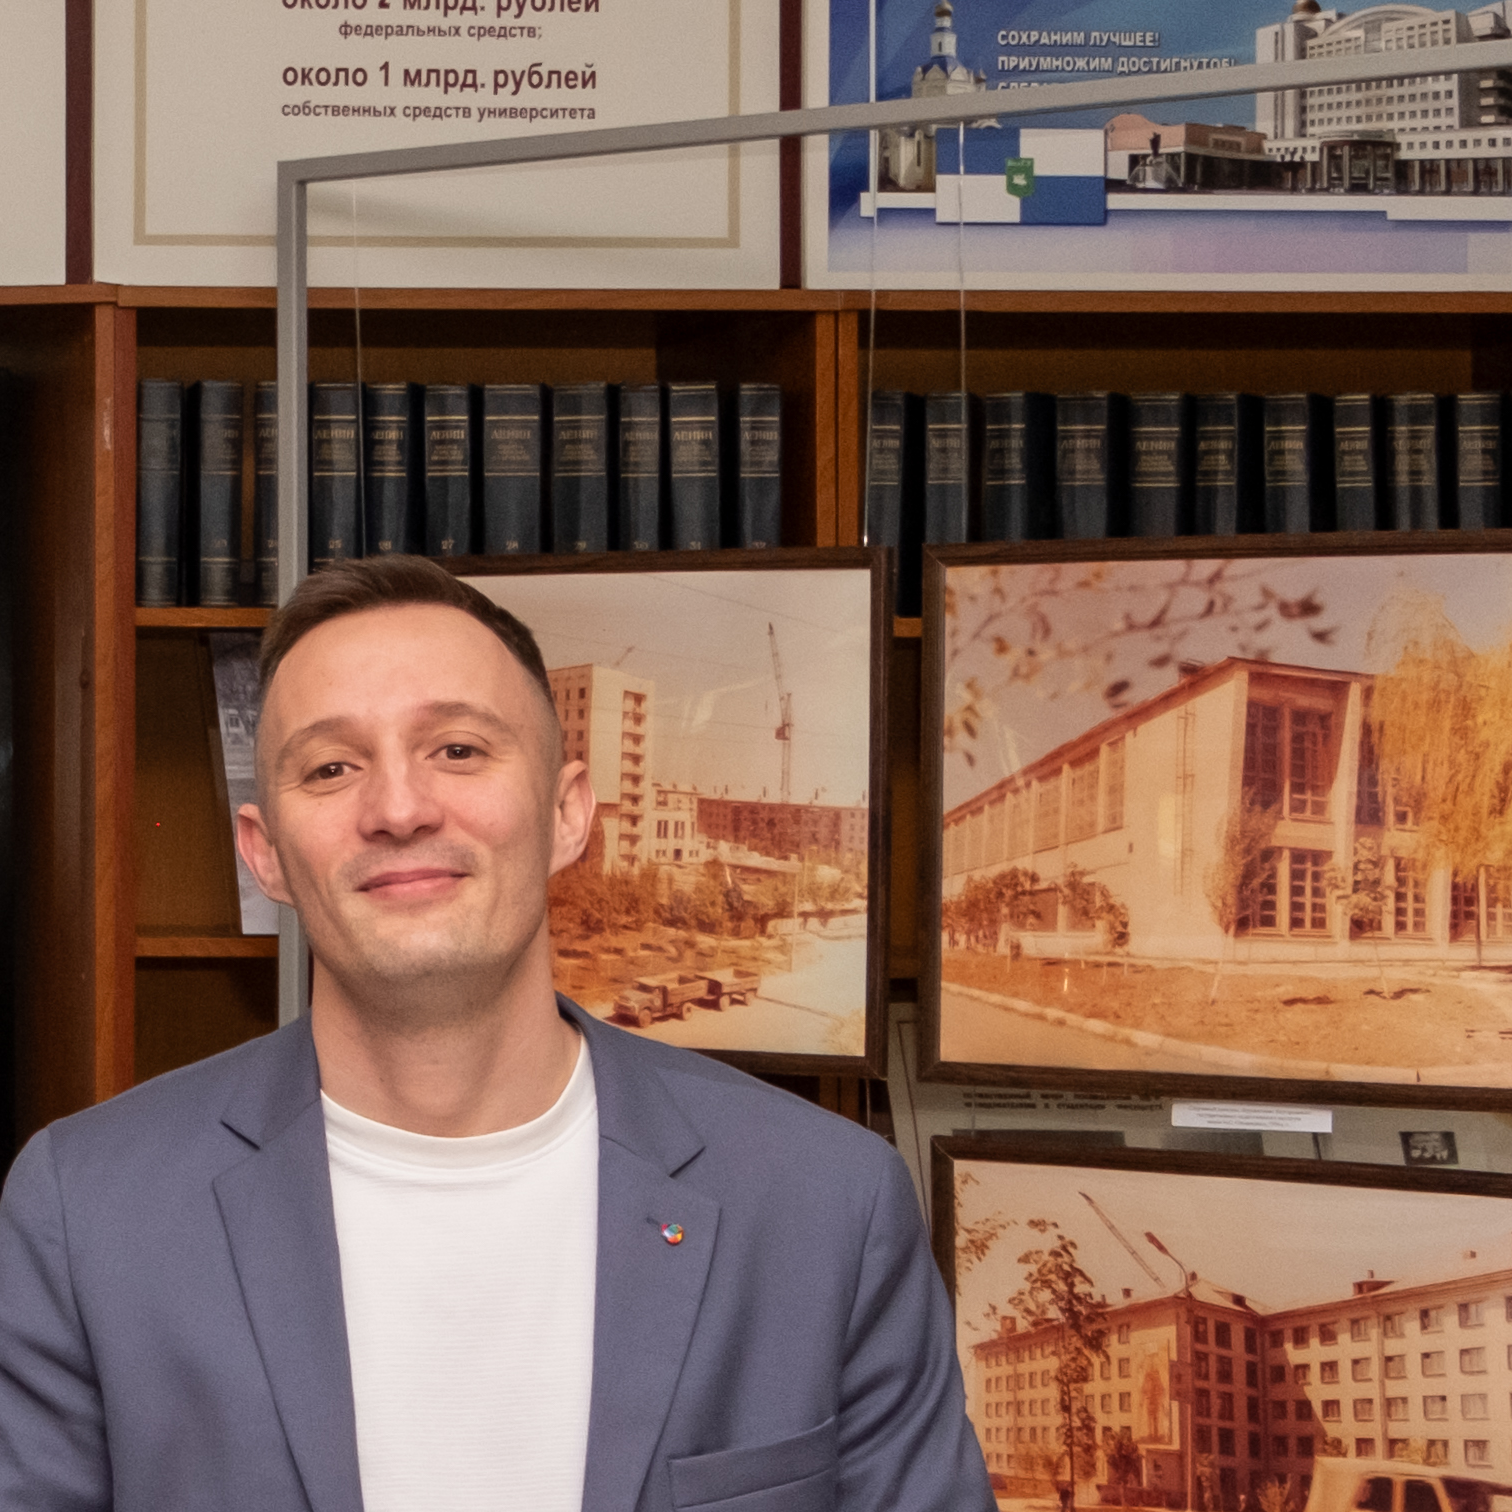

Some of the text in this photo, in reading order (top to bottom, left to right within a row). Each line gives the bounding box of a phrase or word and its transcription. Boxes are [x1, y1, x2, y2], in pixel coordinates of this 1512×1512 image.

[338, 21, 543, 41] федеральных средств;
[997, 30, 1161, 47] СОХРАНИМ ЛУЧШЕЕ!
[997, 56, 1113, 71] ПРИУМНОЖИМ
[281, 61, 598, 96] около 1 млрд. рублей
[281, 101, 597, 122] собственных средств университета
